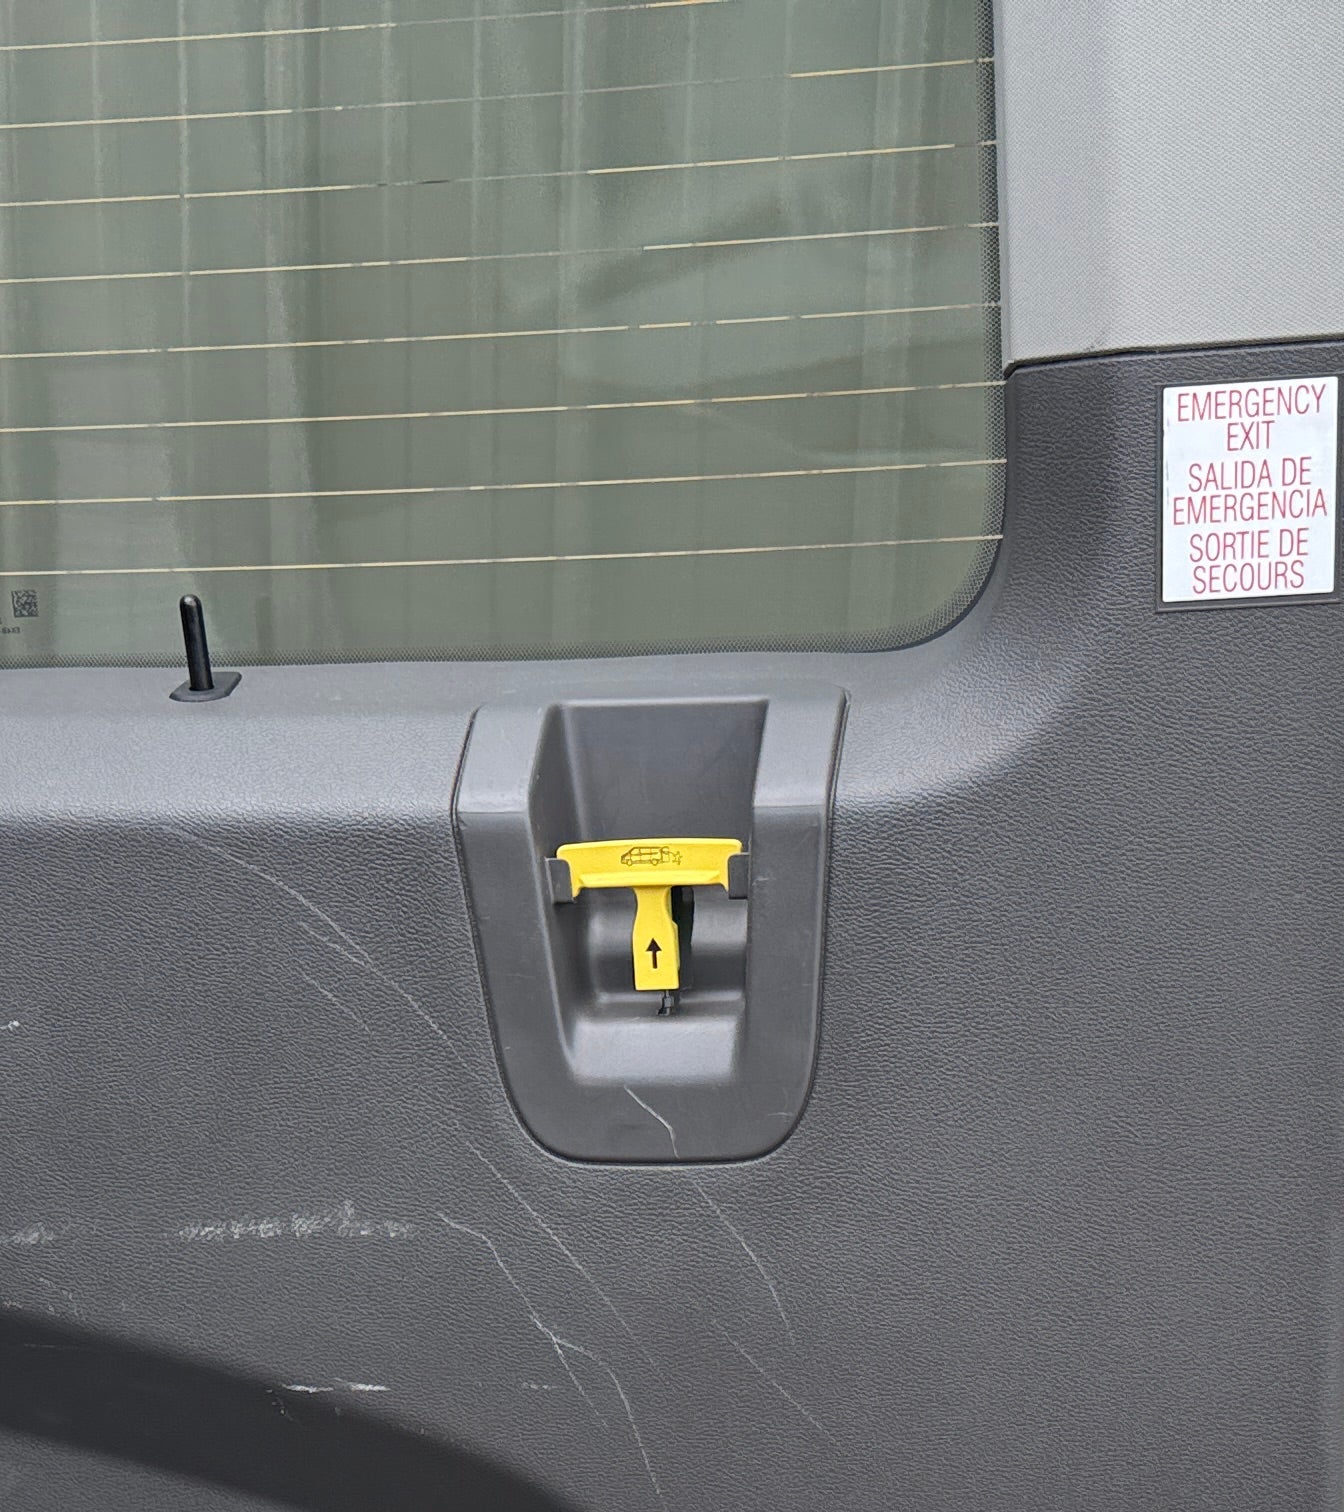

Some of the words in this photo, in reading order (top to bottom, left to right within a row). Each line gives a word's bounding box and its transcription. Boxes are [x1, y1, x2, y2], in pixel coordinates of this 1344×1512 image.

[1177, 383, 1326, 422] EMERGENCY
[1226, 420, 1275, 451] EXIT
[1188, 459, 1273, 492] SALIDA
[1282, 456, 1312, 486] DE
[1173, 488, 1328, 525] EMERGENCIA
[1189, 530, 1270, 563] SORTIE
[1279, 527, 1309, 557] DE
[1192, 559, 1305, 594] SECOURS
